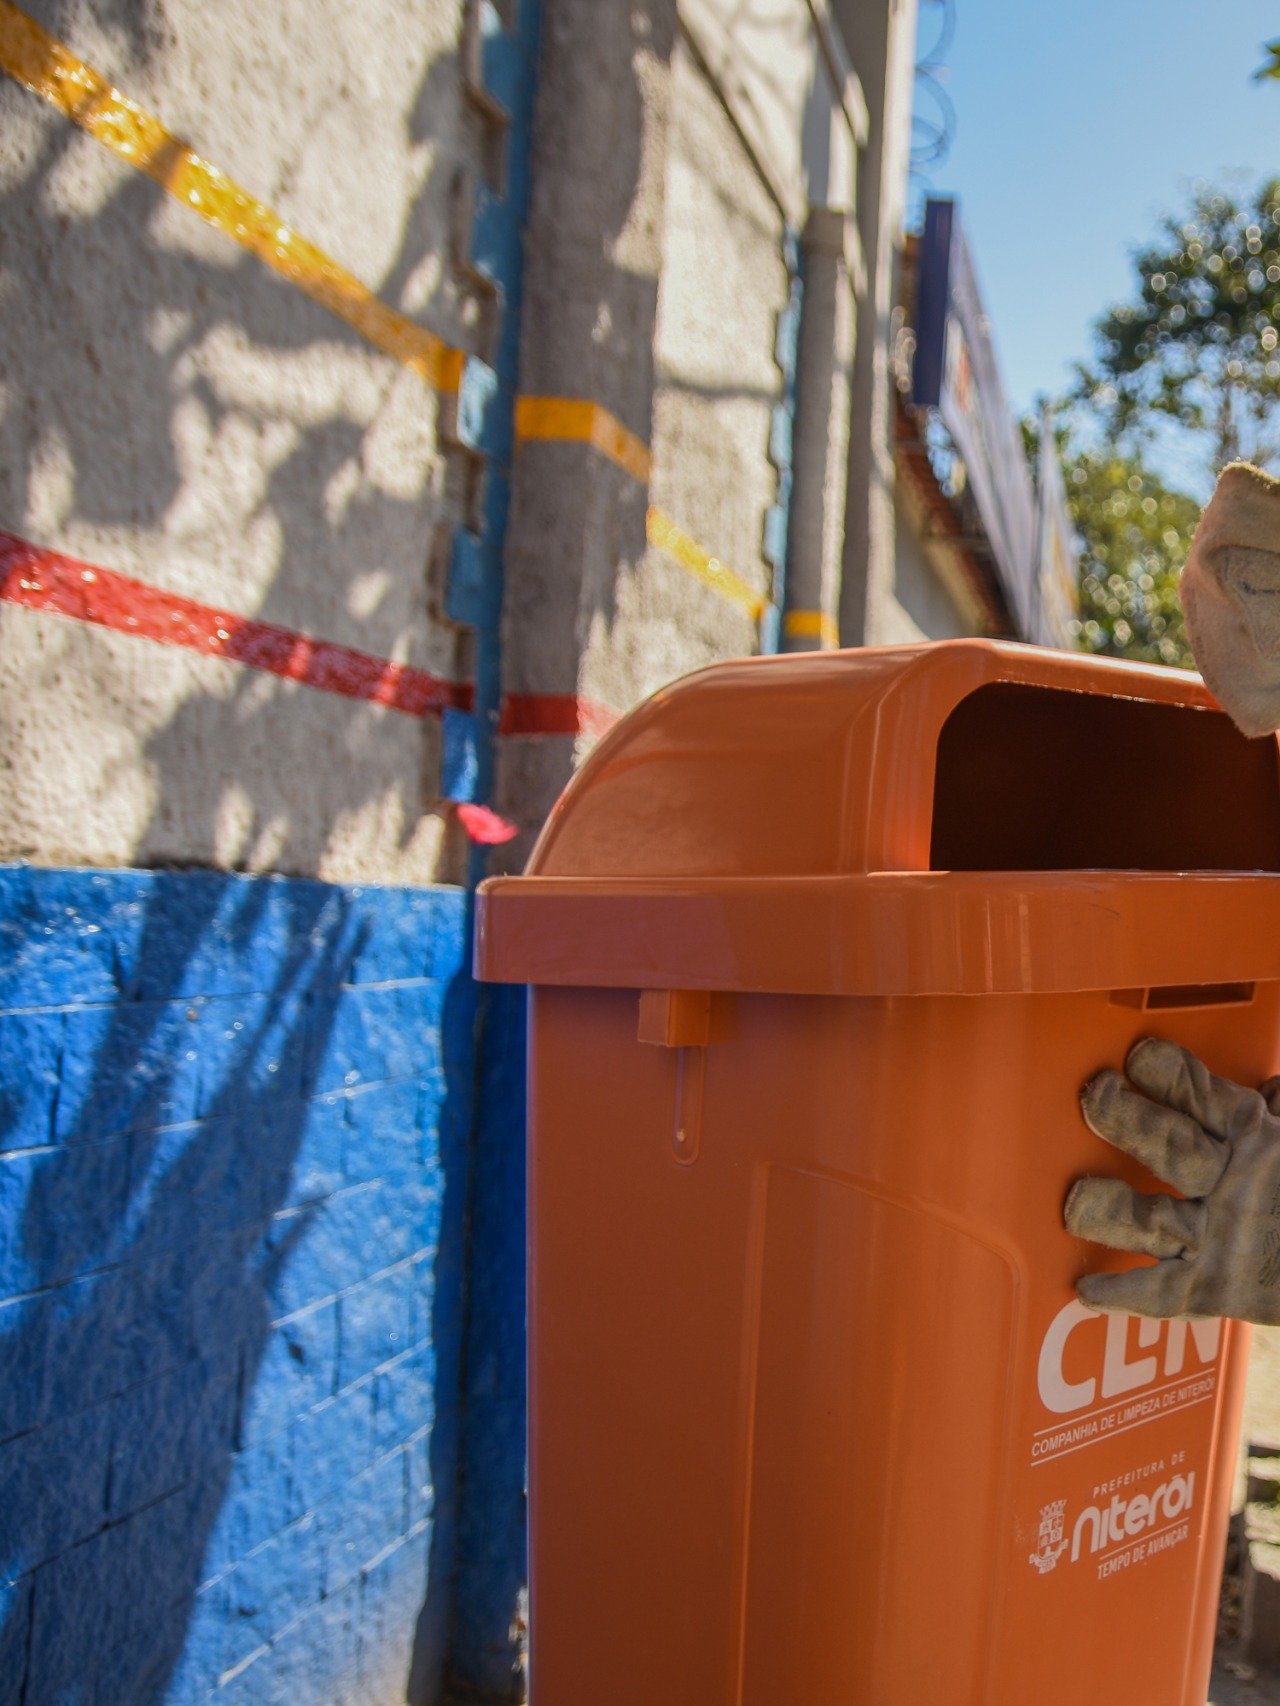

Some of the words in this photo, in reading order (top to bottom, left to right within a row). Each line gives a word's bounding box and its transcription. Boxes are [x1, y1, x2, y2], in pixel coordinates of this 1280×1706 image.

[1031, 1421, 1099, 1457] COMPANHIA
[1100, 1414, 1115, 1430] DE
[1117, 1397, 1161, 1425] LIMPEZA
[1162, 1392, 1176, 1408] DE
[1177, 1377, 1216, 1402] NITERÓI
[1093, 1460, 1166, 1498] PREFEITURA
[1171, 1450, 1186, 1465] DE
[1097, 1556, 1130, 1580] TEMPO
[1132, 1549, 1146, 1566] DE
[1146, 1524, 1189, 1556] AVANÇAR
